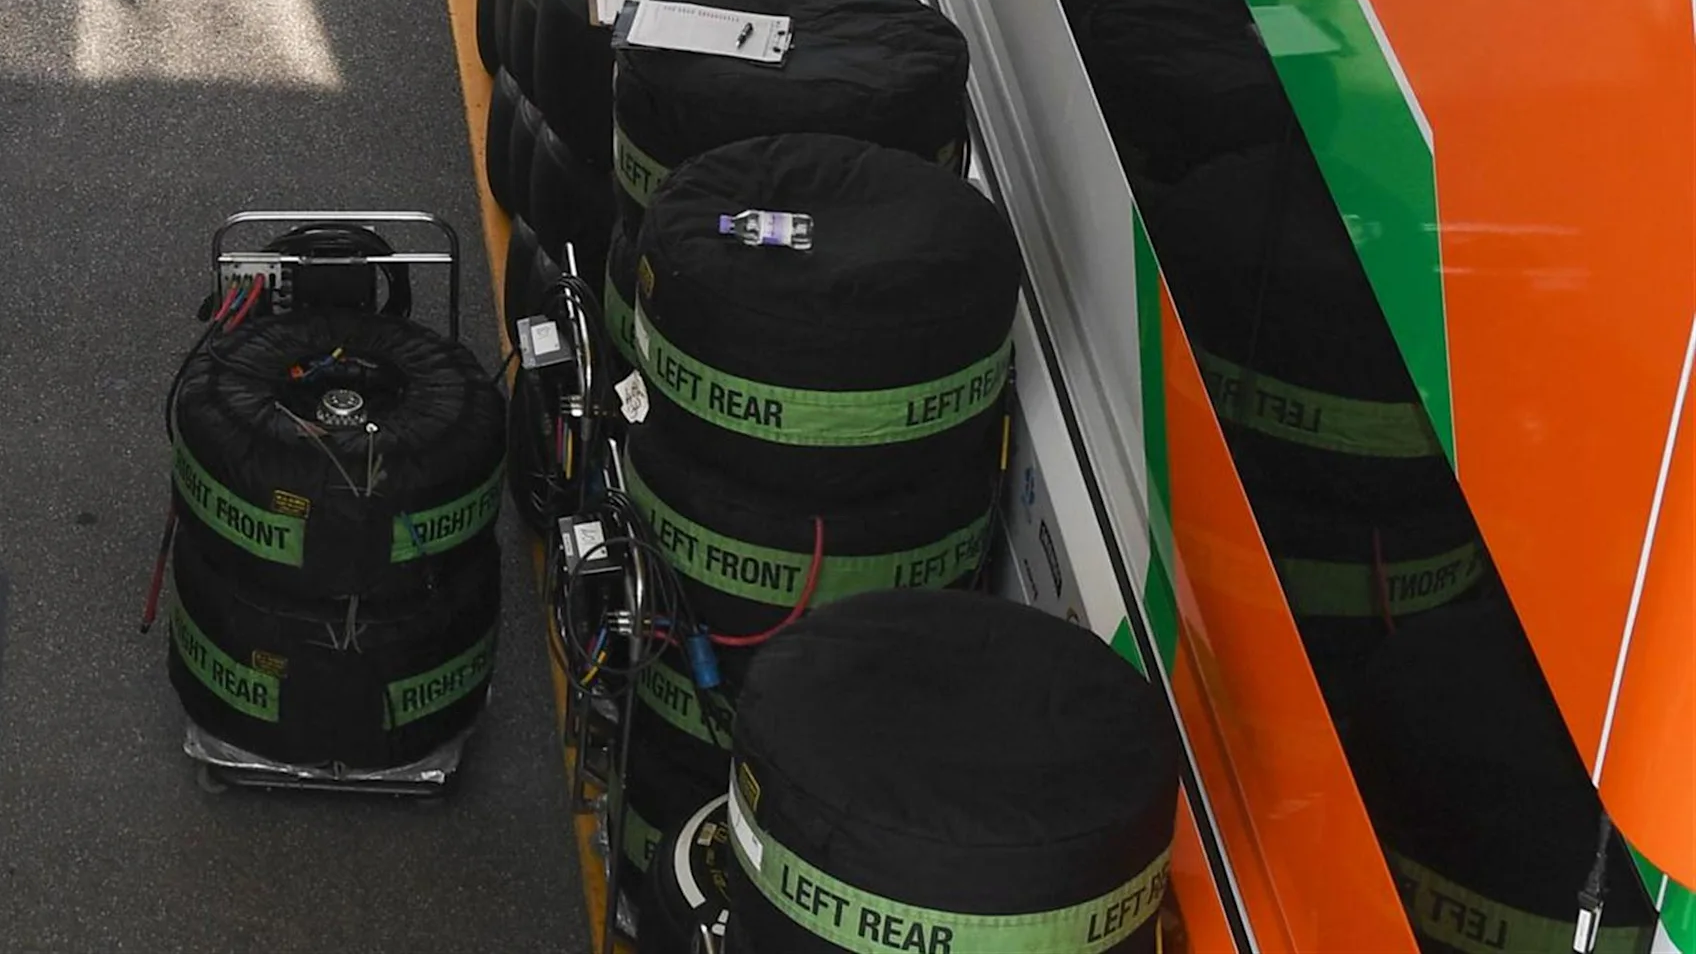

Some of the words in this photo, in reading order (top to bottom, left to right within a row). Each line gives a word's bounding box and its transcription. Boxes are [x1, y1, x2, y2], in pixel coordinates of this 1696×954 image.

[620, 144, 652, 193] LEFT
[657, 347, 703, 400] LEFT
[709, 386, 783, 429] REAR
[906, 383, 966, 427] LEFT
[216, 495, 291, 550] FRONT
[648, 506, 701, 565] LEFT
[705, 547, 802, 594] FRONT
[212, 658, 268, 710] REAR
[780, 863, 851, 928] LEFT
[858, 906, 954, 954] REAR
[1087, 886, 1146, 944] LEFT
